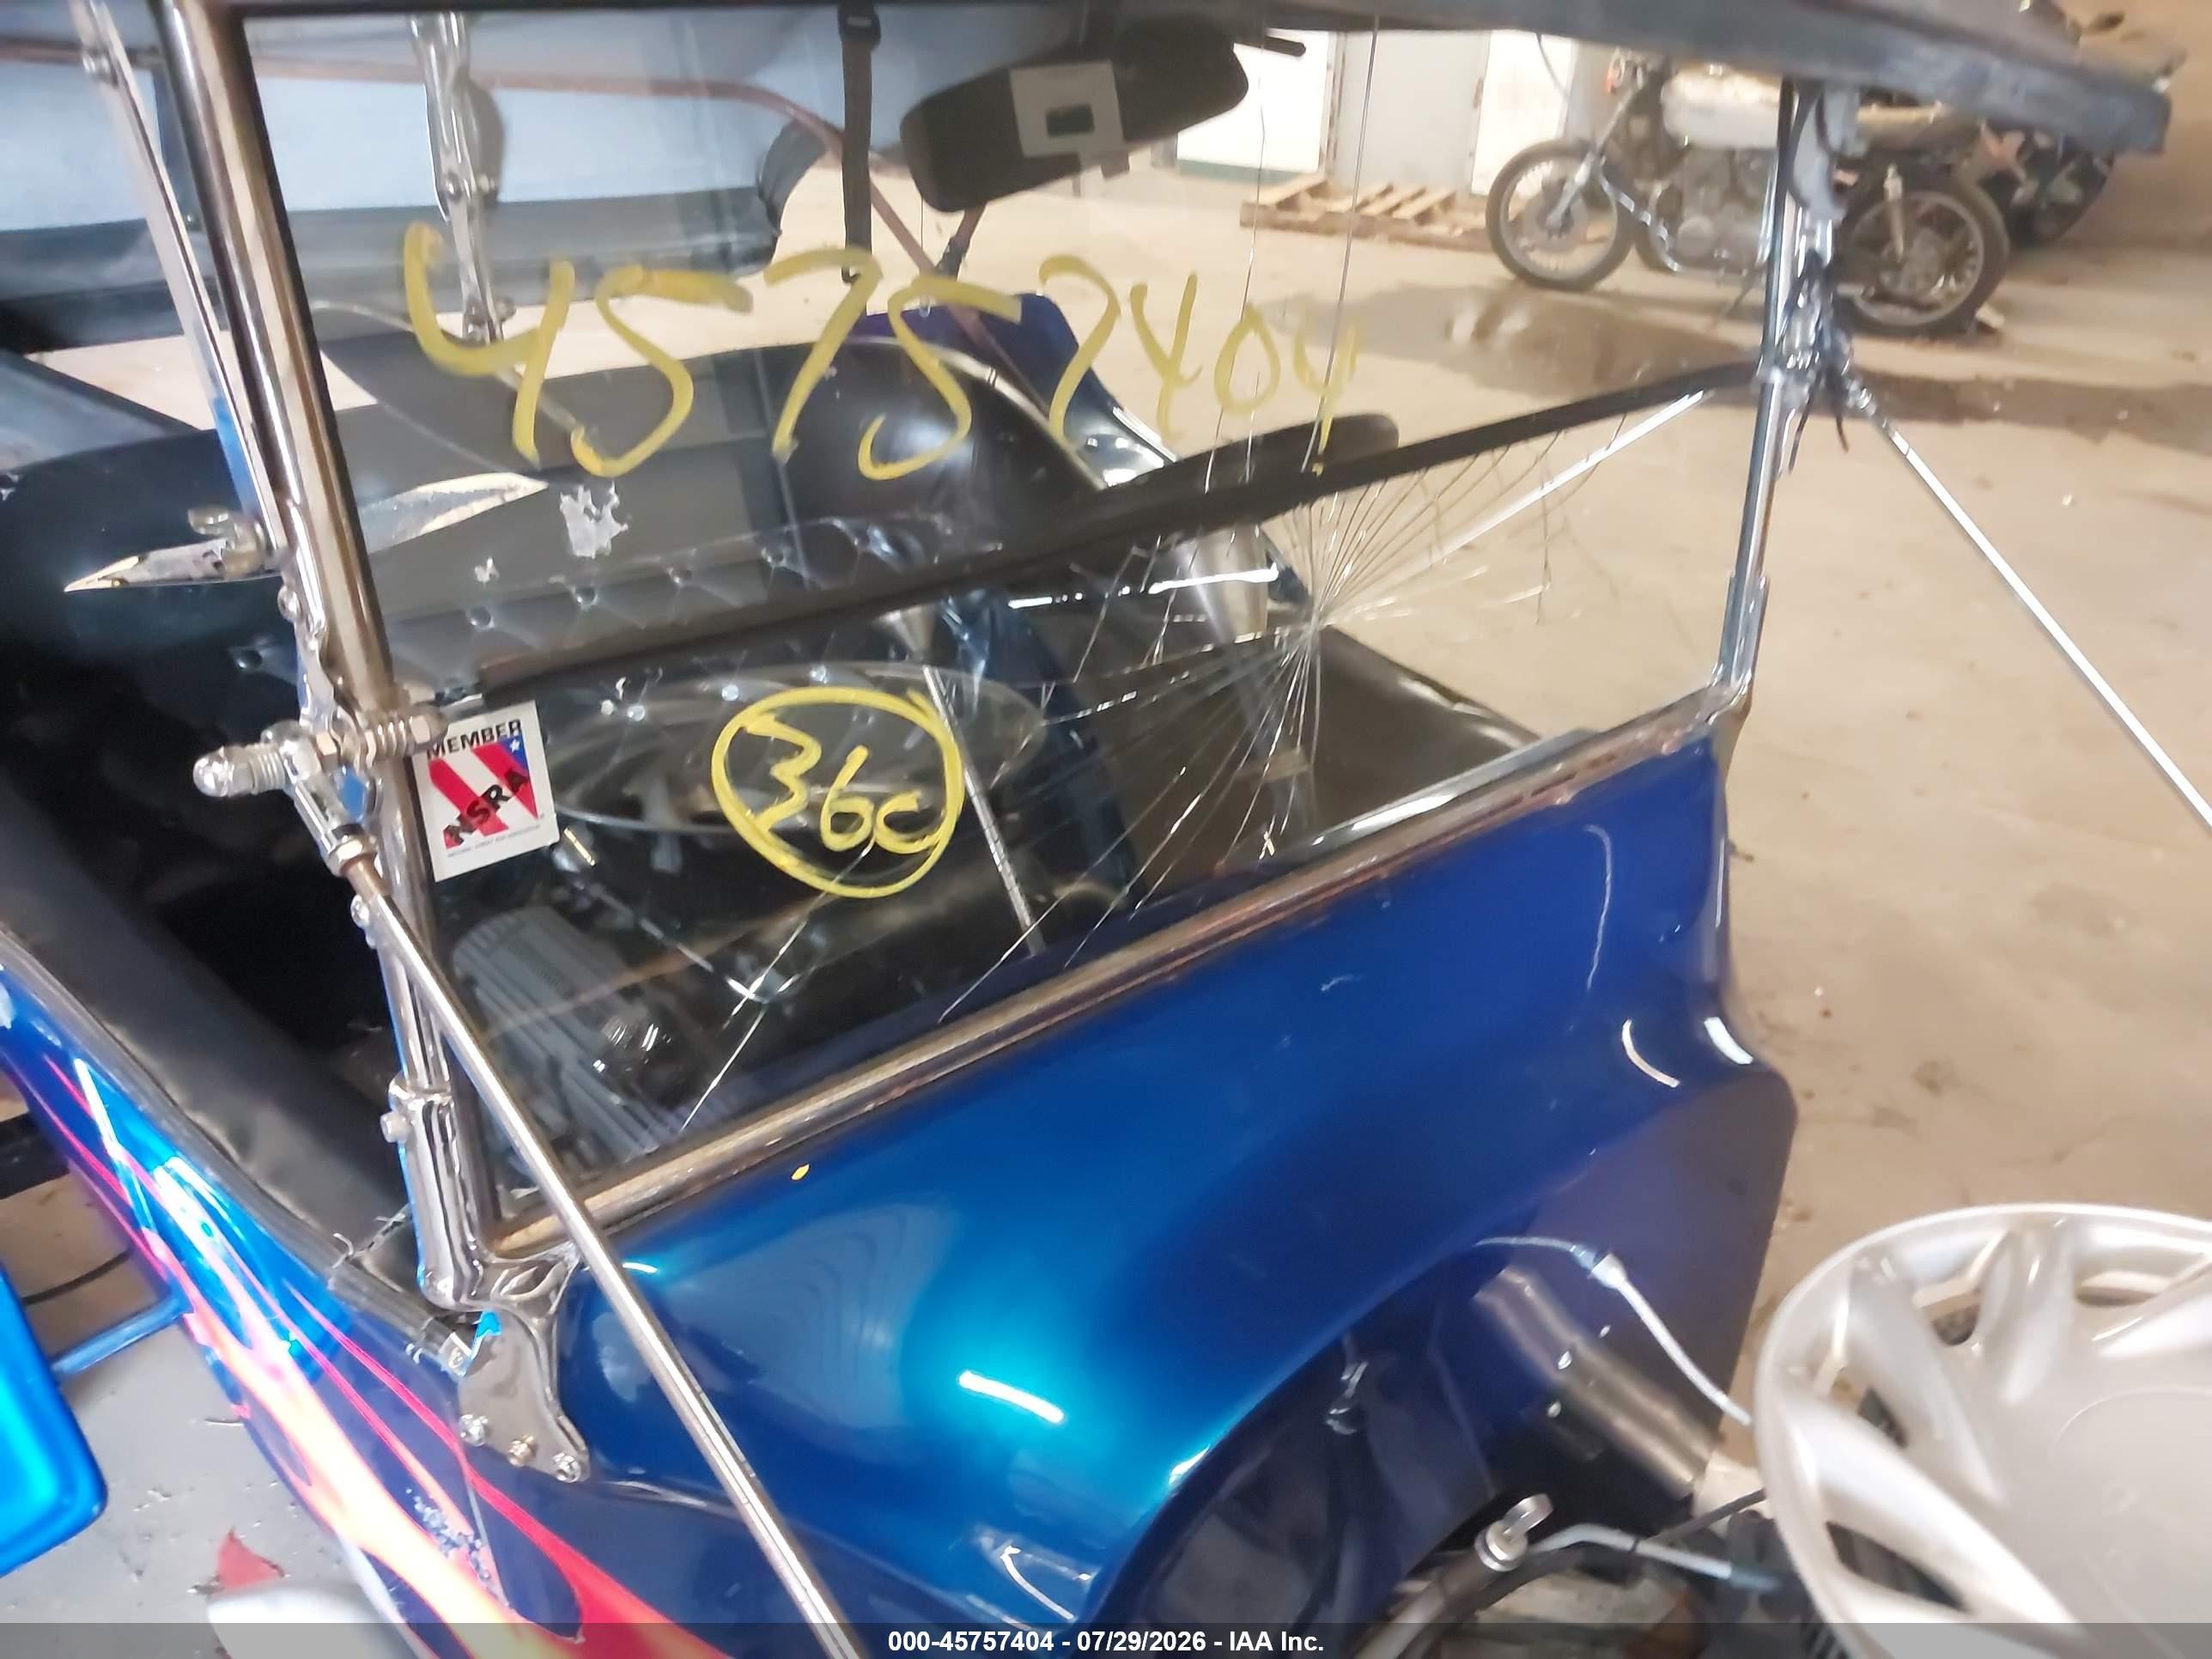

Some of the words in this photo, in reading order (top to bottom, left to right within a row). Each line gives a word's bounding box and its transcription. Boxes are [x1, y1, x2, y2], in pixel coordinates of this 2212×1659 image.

[404, 222, 1358, 481] 45757404
[427, 718, 521, 759] MEMBER
[442, 769, 530, 849] NSRA
